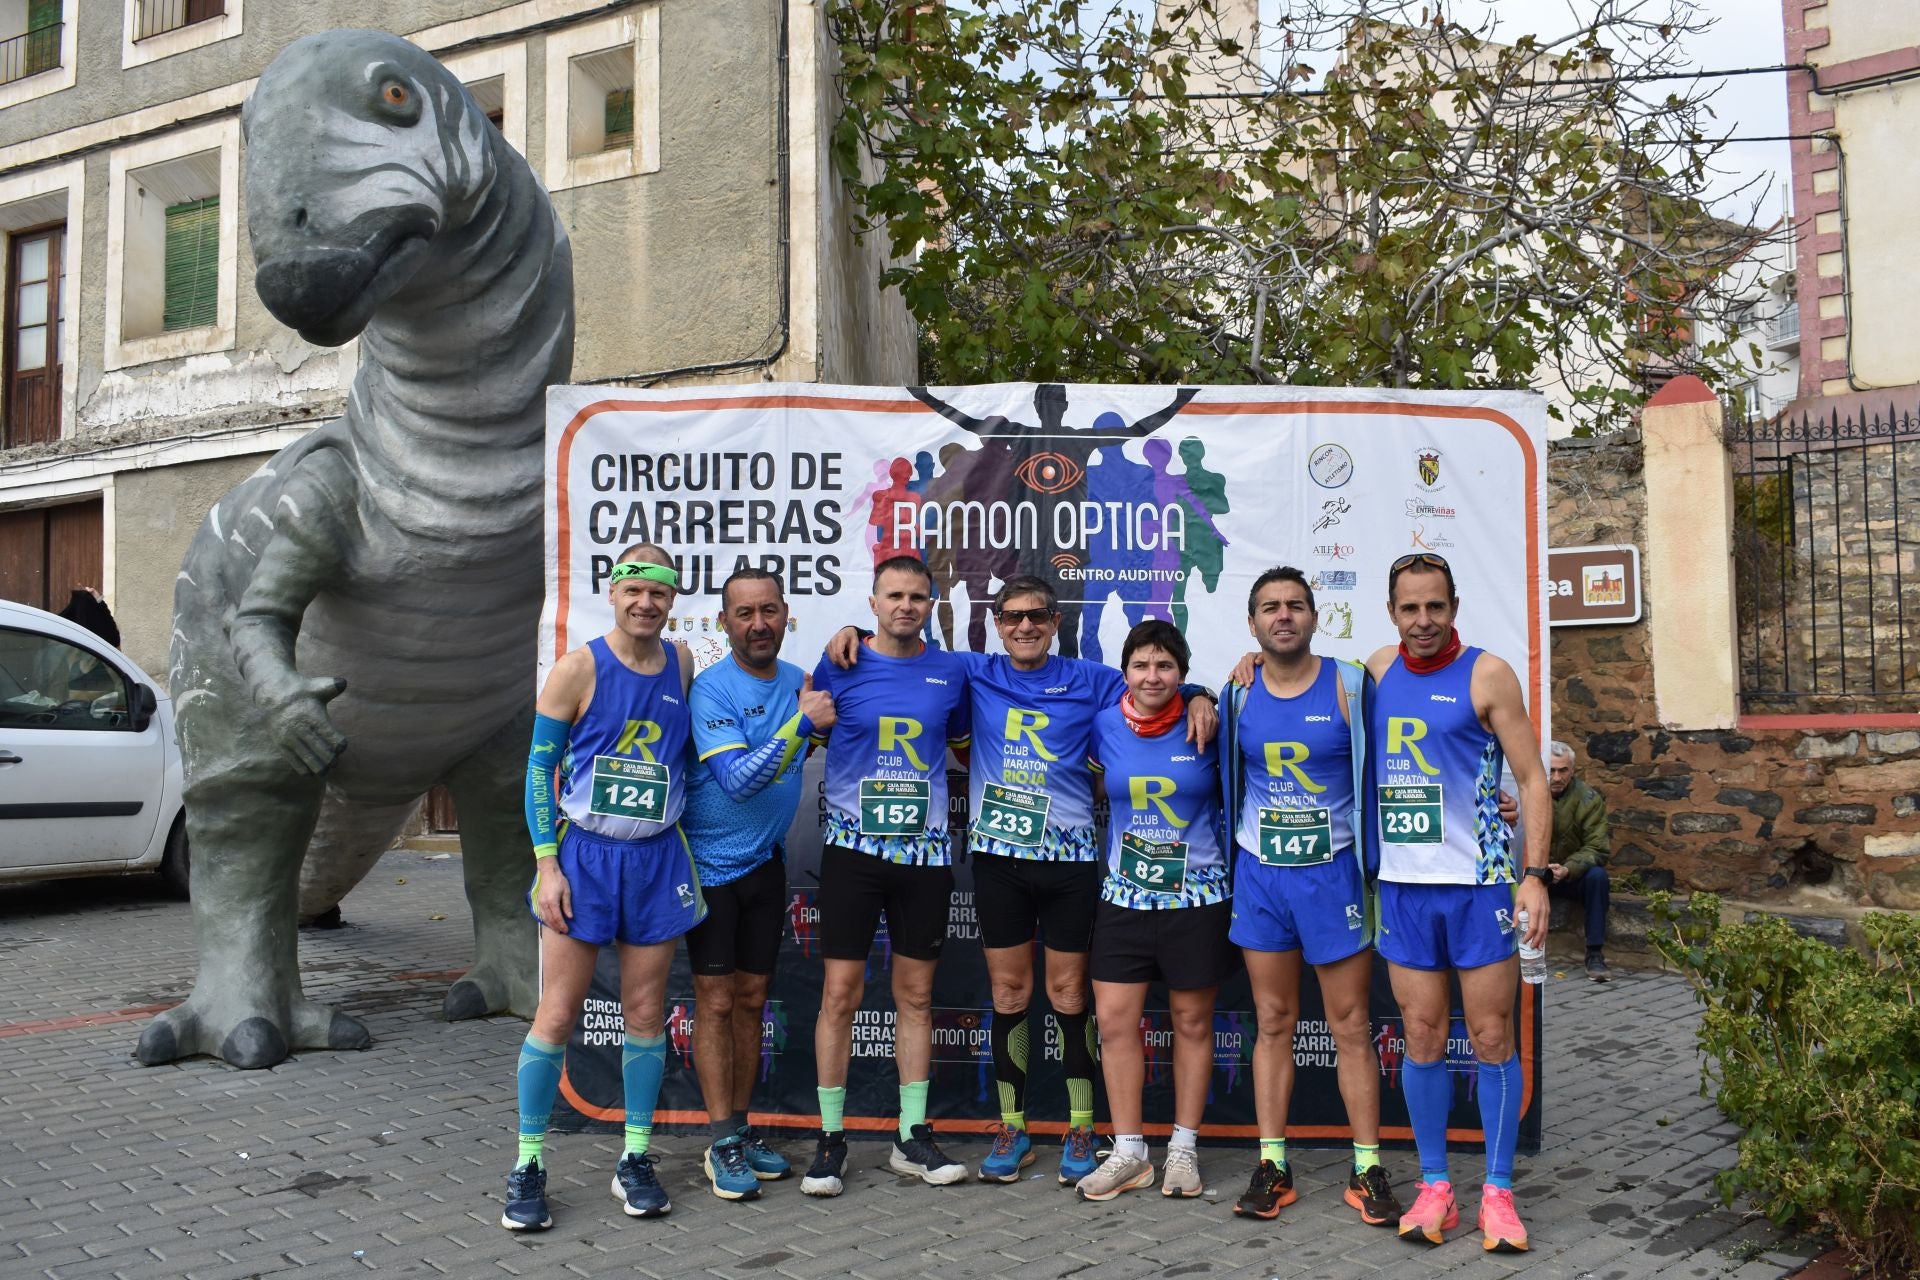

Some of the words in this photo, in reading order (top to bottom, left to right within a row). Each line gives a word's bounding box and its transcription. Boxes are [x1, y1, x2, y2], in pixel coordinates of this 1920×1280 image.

[591, 452, 775, 492] CIRCUITO
[791, 452, 842, 490] DE
[589, 499, 842, 545] CARRERAS
[893, 500, 1038, 550] RAMON
[1053, 501, 1185, 551] OPTICA
[1059, 569, 1115, 581] CENTRO
[1118, 569, 1185, 582] AUDITIVO
[615, 720, 662, 764] R
[878, 716, 929, 771] R
[1004, 707, 1059, 762] R
[1003, 744, 1029, 756] CLUB
[1386, 716, 1441, 776] R
[877, 755, 903, 767] CLUB
[1003, 758, 1048, 772] MARATÓN
[1263, 741, 1328, 794] R
[1386, 759, 1410, 770] CLUB
[876, 769, 920, 780] MARATÓN
[1002, 769, 1046, 785] RIOJA
[1387, 772, 1429, 784] MARATÓN
[605, 783, 655, 809] 124
[1269, 781, 1294, 793] CLUB
[1128, 776, 1190, 828] R
[1270, 793, 1317, 806] MARATÓN
[534, 806, 550, 834] RIOJA
[872, 804, 918, 824] 152
[988, 809, 1033, 836] 233
[1132, 814, 1158, 825] CLUB
[1386, 812, 1430, 834] 230
[1132, 827, 1180, 840] MARATÓN
[1270, 834, 1319, 855] 147
[1135, 860, 1165, 884] 82
[676, 884, 695, 897] R
[1345, 904, 1363, 919] R
